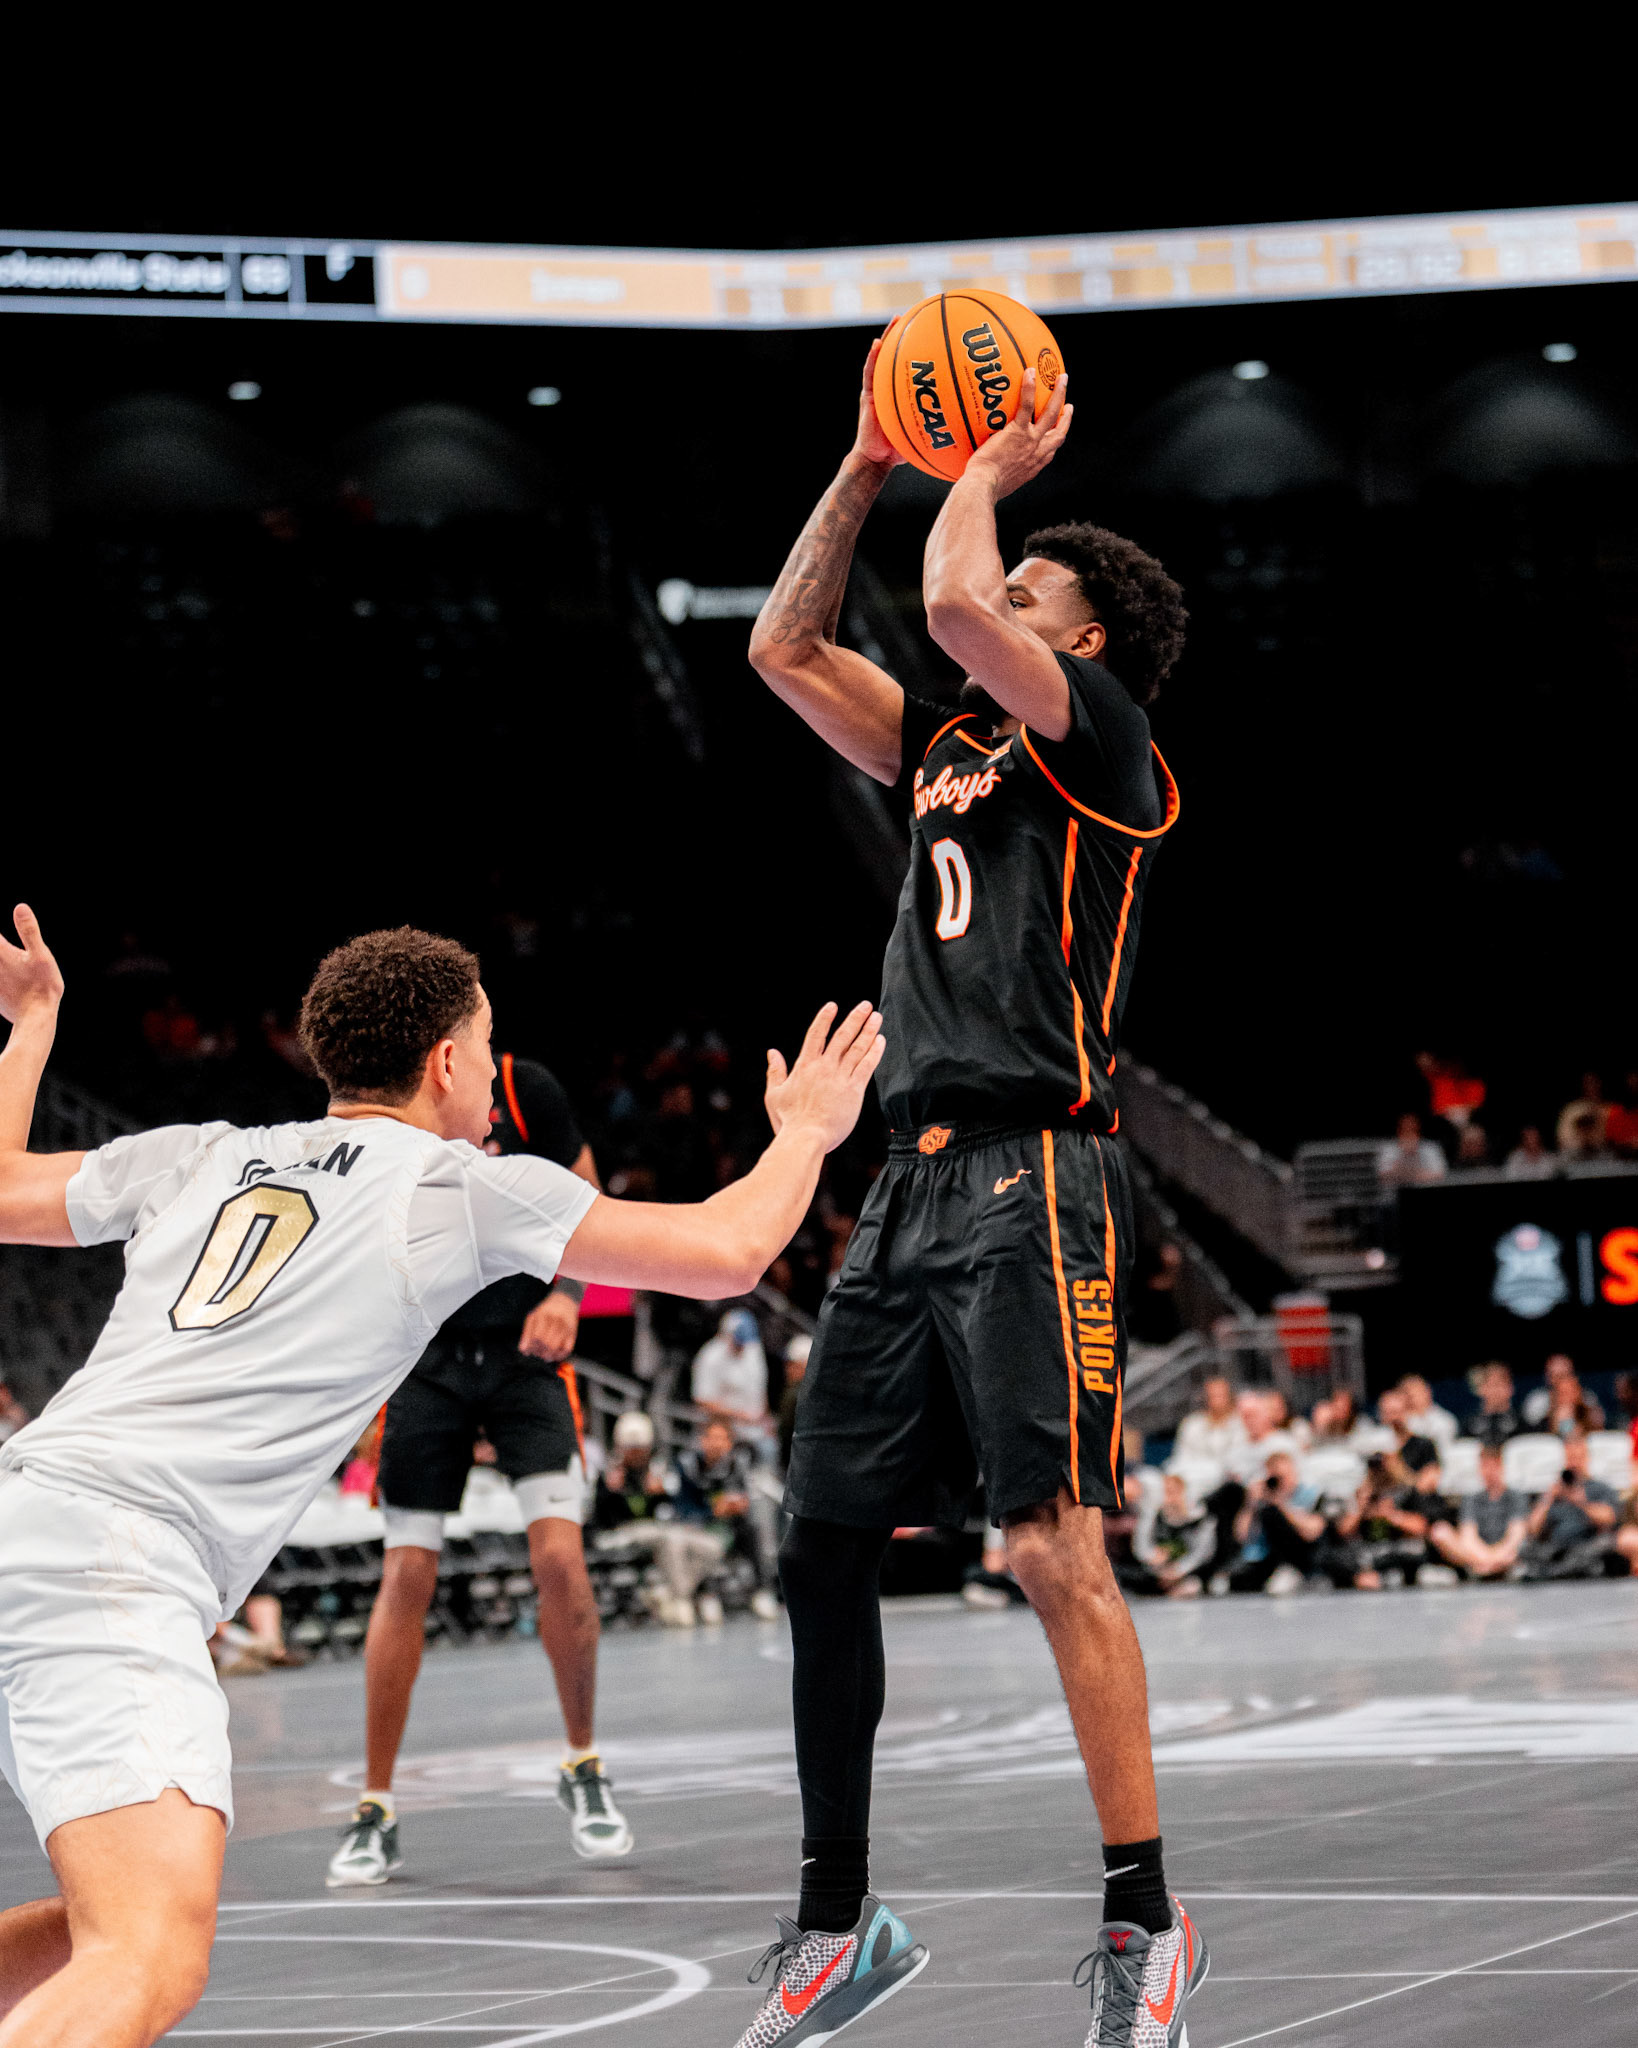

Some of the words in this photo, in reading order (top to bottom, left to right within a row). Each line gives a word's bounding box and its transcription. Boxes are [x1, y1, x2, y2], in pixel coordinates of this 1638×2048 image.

[911, 360, 956, 450] NCAA
[962, 322, 1010, 440] Wilso
[931, 837, 972, 942] 0
[918, 1126, 953, 1155] OSU
[168, 1182, 320, 1332] 0
[1072, 1279, 1116, 1394] POKES
